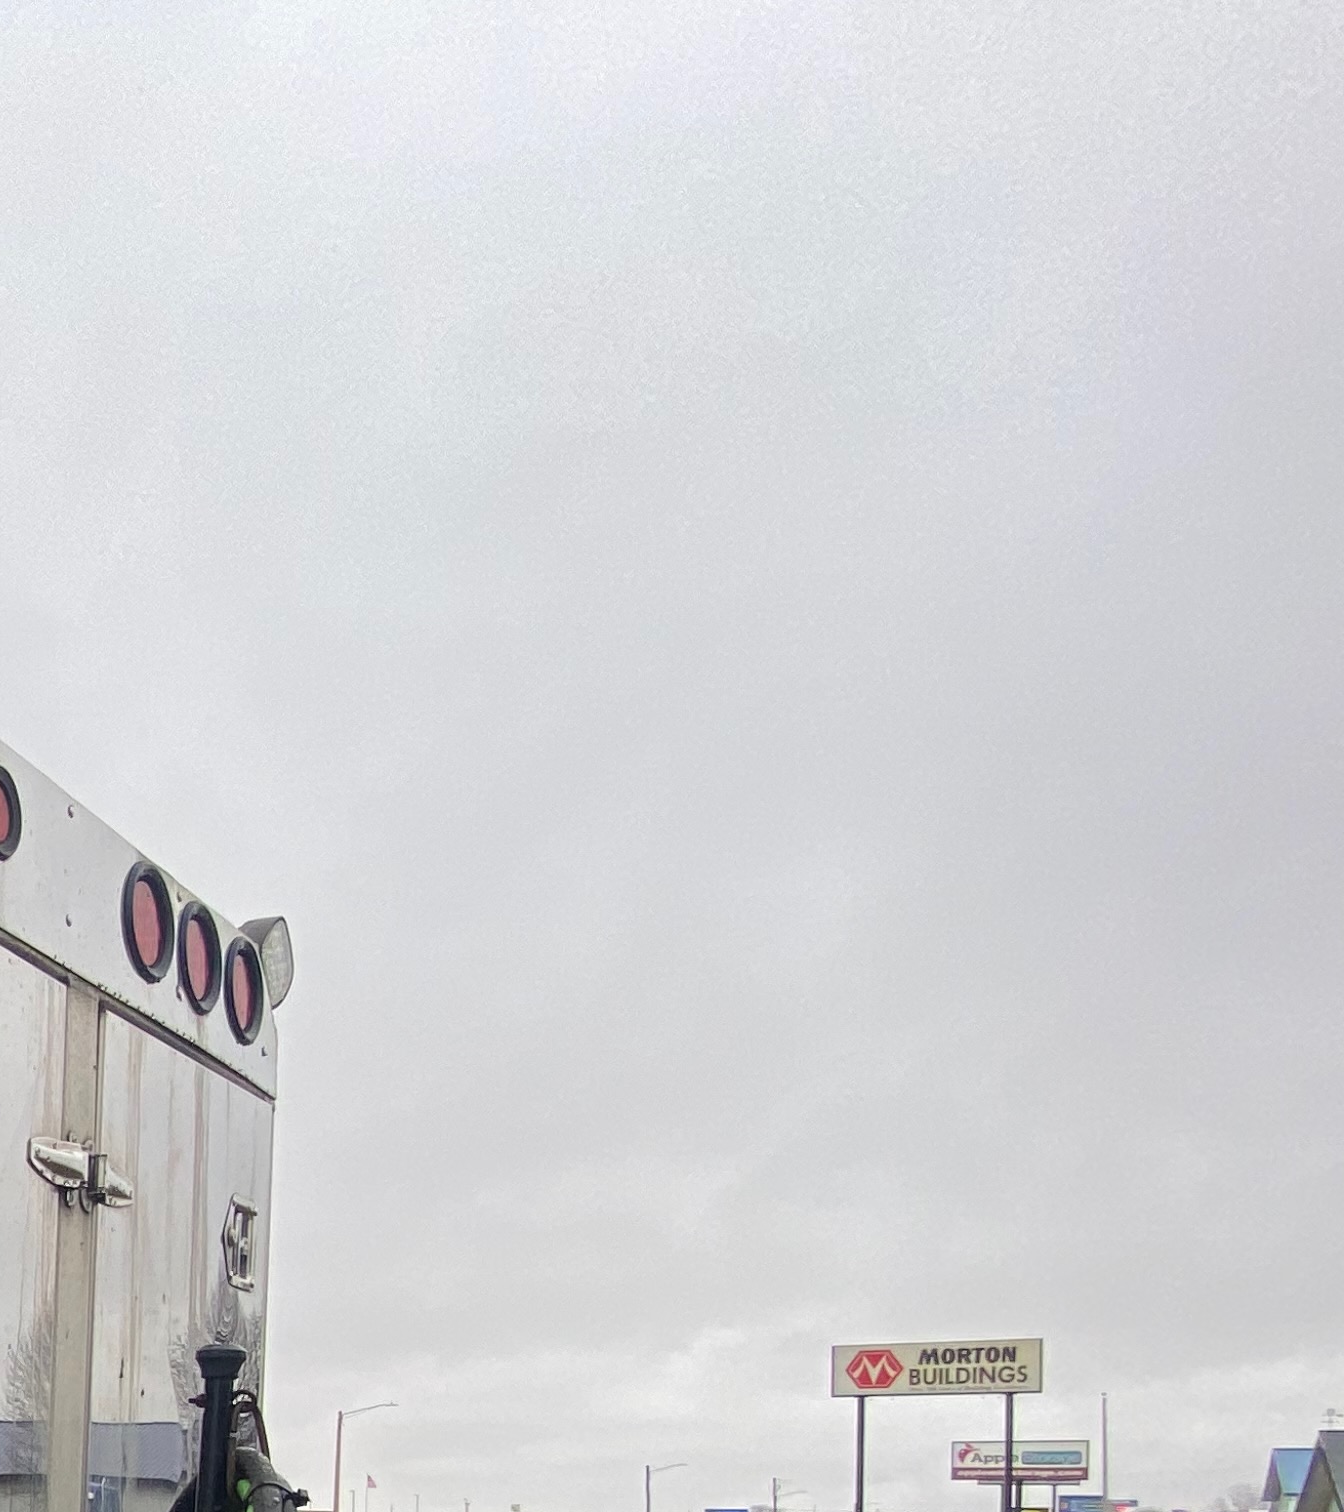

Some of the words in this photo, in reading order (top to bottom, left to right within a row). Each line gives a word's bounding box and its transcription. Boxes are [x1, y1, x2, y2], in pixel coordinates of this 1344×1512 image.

[918, 1346, 1017, 1365] MORTON
[909, 1365, 1028, 1386] BUILDINGS
[970, 1452, 1019, 1465] Appe
